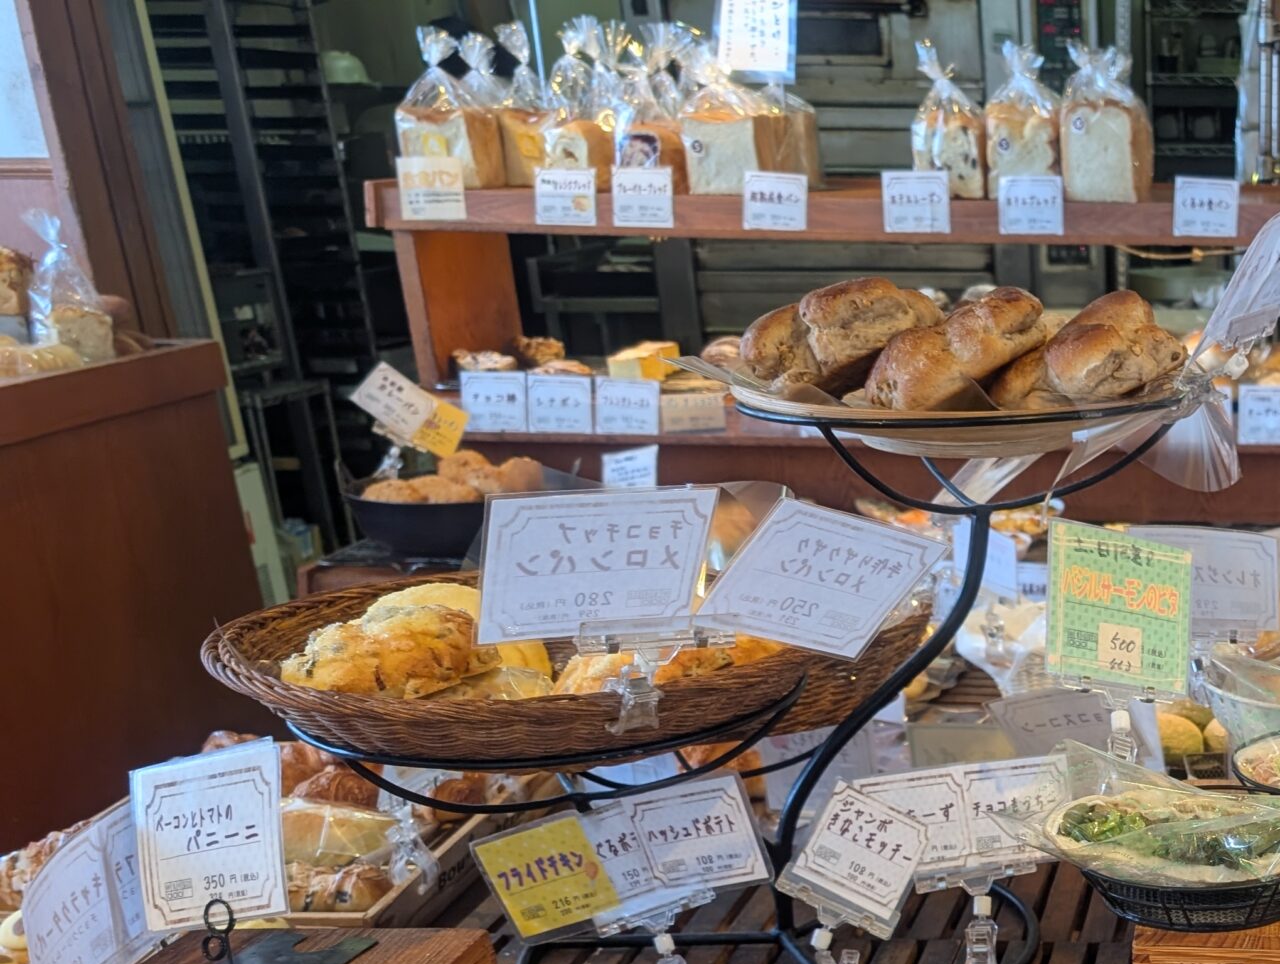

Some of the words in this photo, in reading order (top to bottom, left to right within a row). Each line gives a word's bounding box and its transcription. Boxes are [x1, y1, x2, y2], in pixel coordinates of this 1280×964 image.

[1110, 632, 1136, 653] 500
[840, 800, 894, 832] ジャンボ
[186, 825, 259, 852] パニーニ
[648, 813, 737, 844] ハッシュドポテト
[498, 851, 584, 891] フライドチキン
[622, 868, 641, 881] 150
[848, 859, 866, 875] 108
[203, 872, 226, 891] 350
[552, 896, 572, 911] 216
